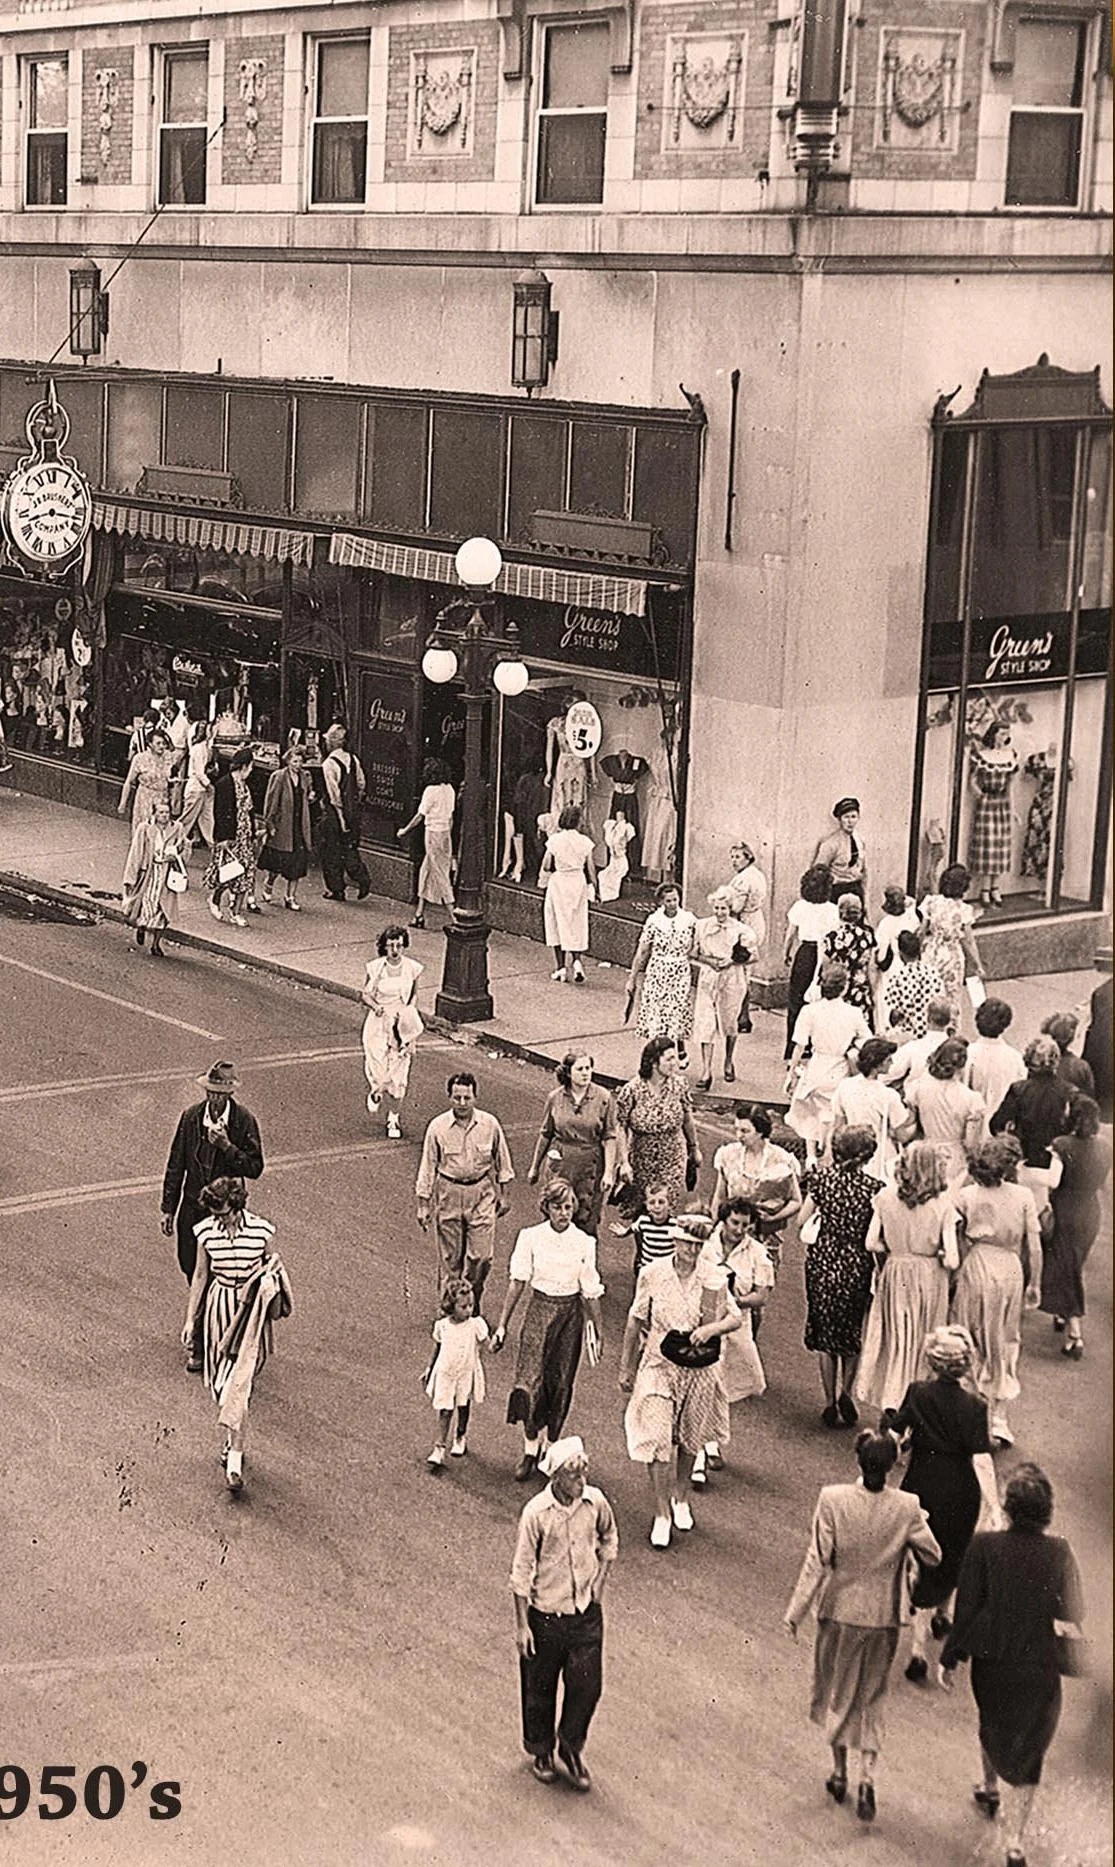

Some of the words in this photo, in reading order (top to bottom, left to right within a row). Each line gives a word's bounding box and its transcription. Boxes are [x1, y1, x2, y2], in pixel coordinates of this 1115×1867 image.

[34, 521, 70, 534] COMPANY
[560, 603, 622, 649] Green's
[573, 634, 595, 649] STYLE
[598, 637, 619, 650] SHOP
[1028, 659, 1051, 673] SHOP
